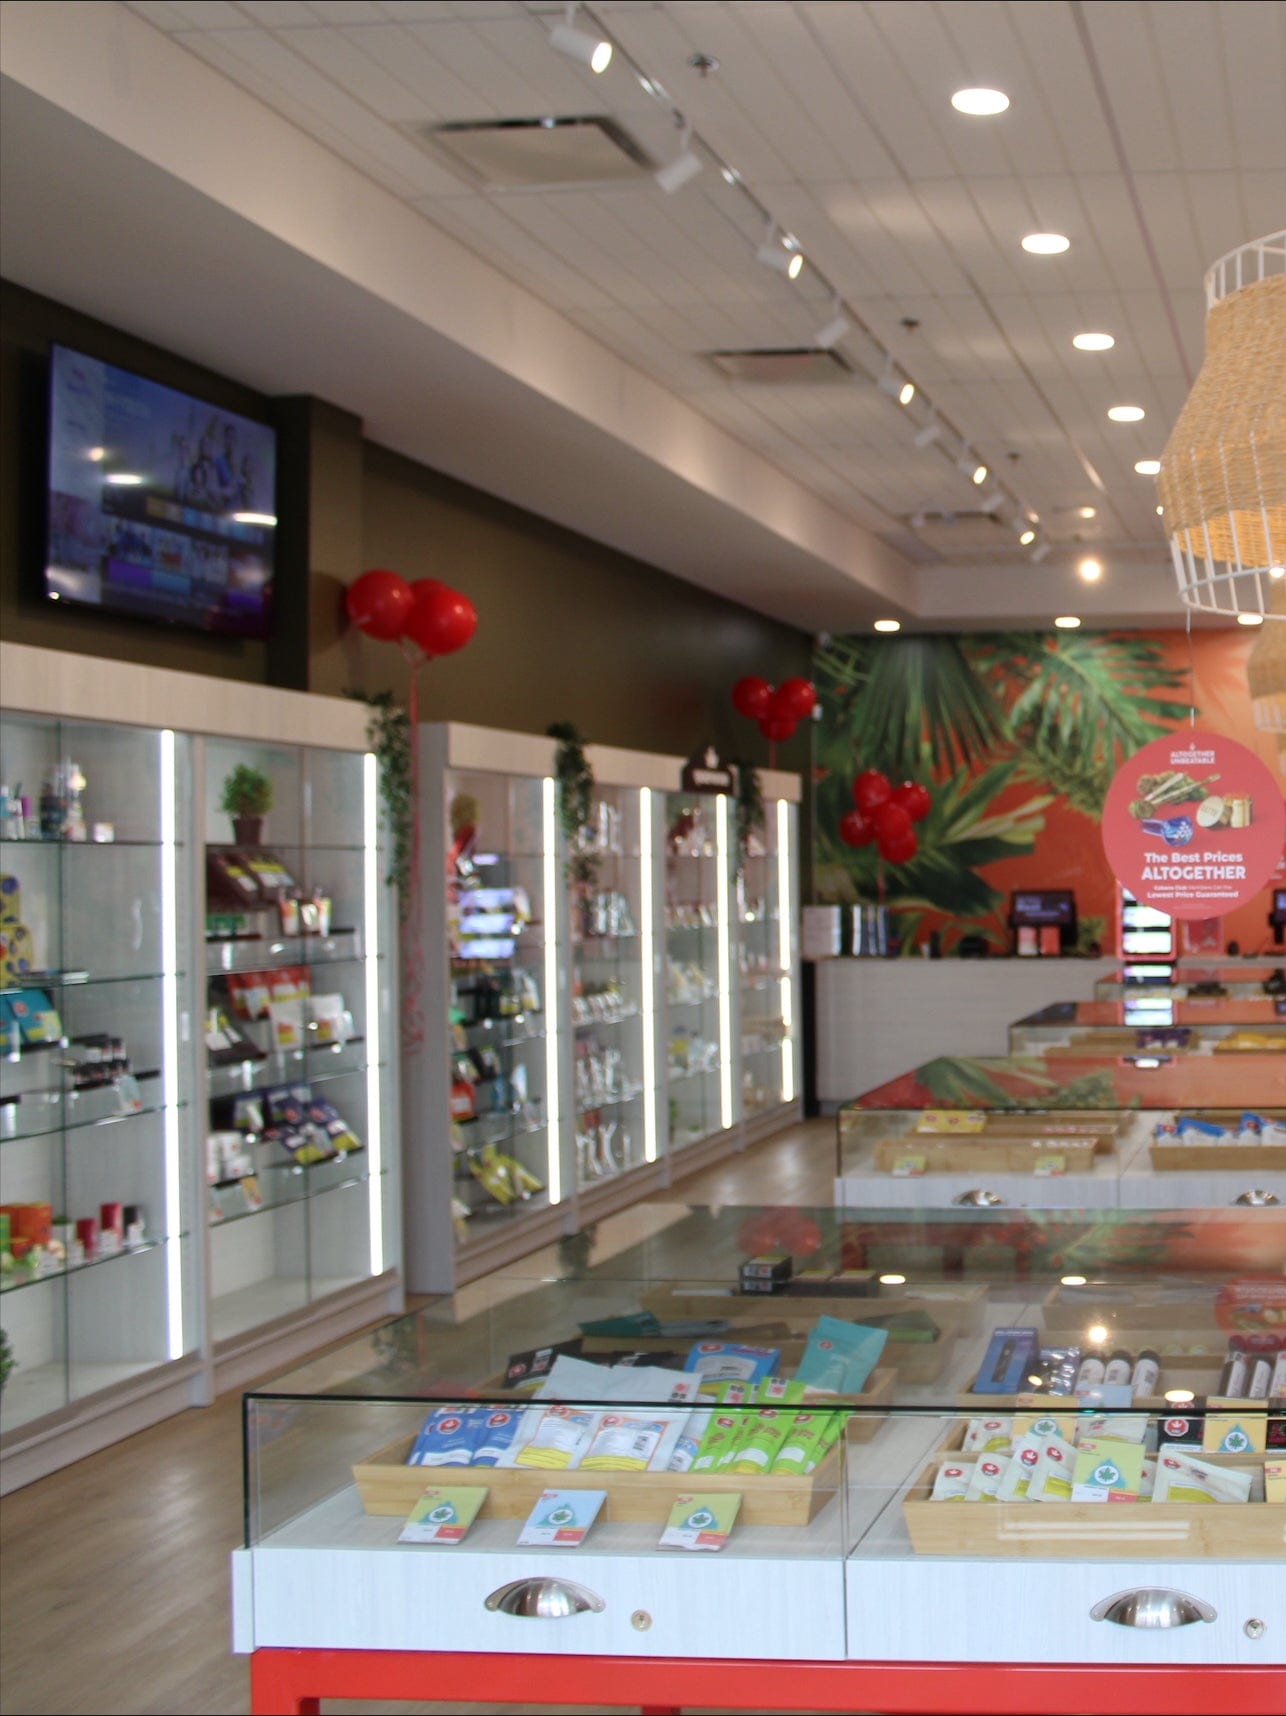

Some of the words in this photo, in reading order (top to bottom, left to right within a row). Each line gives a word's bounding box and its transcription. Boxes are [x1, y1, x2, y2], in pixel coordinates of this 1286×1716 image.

[1144, 852, 1169, 864] The
[1171, 852, 1201, 863] Best
[1203, 851, 1244, 863] Prices
[1141, 866, 1246, 880] ALTOGETHER
